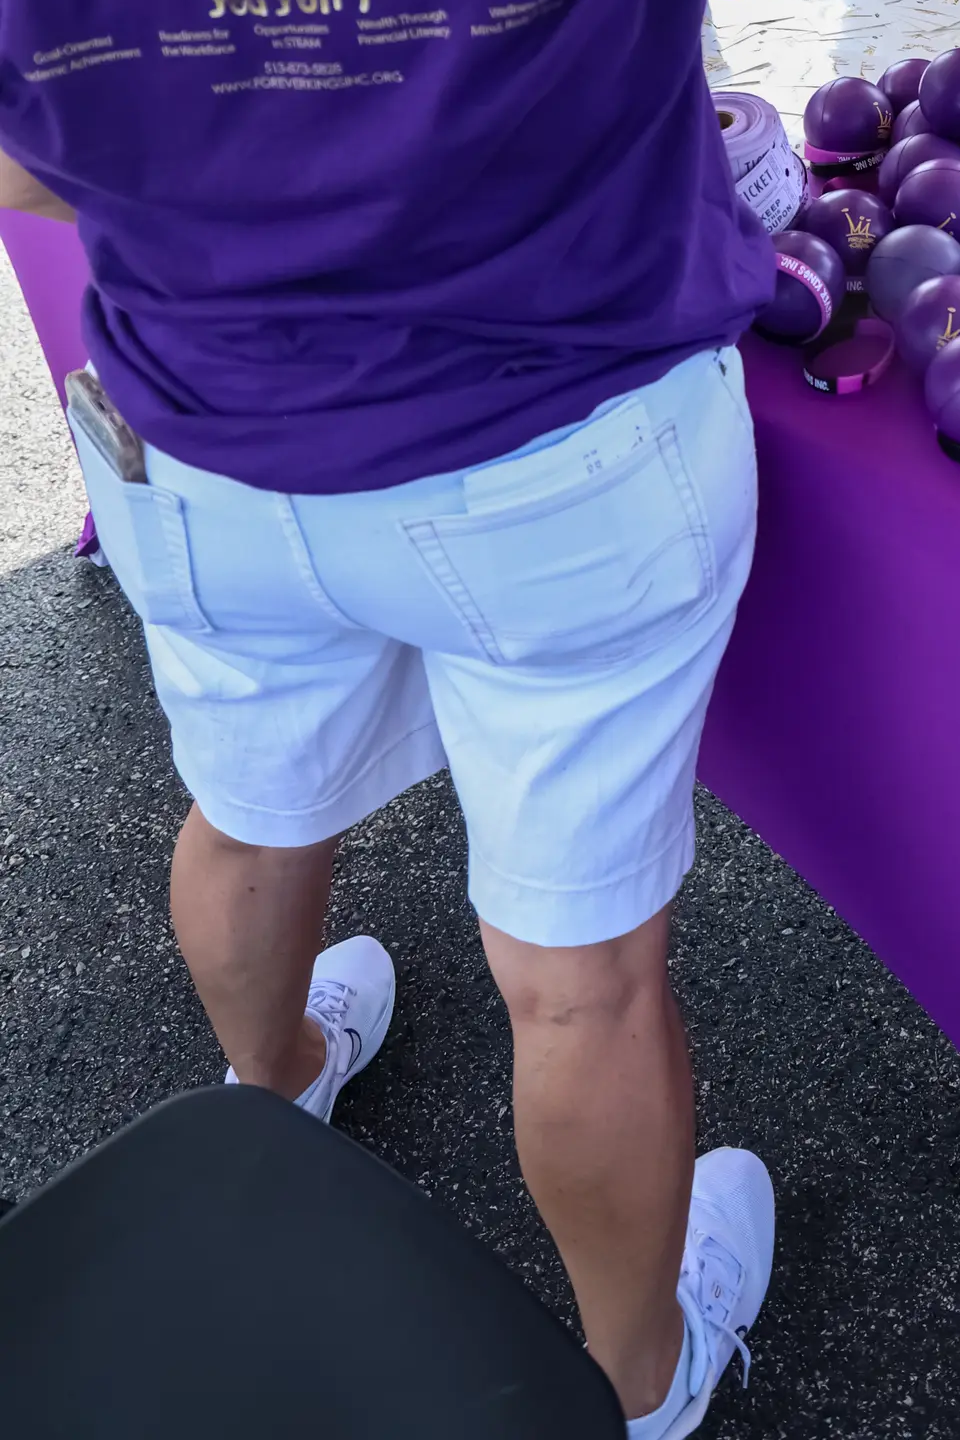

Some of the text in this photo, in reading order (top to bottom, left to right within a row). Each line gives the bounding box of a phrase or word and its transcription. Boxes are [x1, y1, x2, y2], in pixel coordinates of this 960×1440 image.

[356, 9, 448, 31] Wealth Through
[158, 28, 230, 43] Readiness for
[253, 23, 329, 37] Opportunities
[357, 25, 450, 46] Financial Literacy
[179, 43, 236, 57] Workforce
[284, 37, 322, 49] STEAM
[69, 47, 143, 72] Achievement
[743, 168, 773, 202] ICKET
[766, 204, 793, 234] OUPON
[781, 256, 797, 270] INC.
[797, 266, 824, 293] KINGS
[846, 281, 864, 292] INC.
